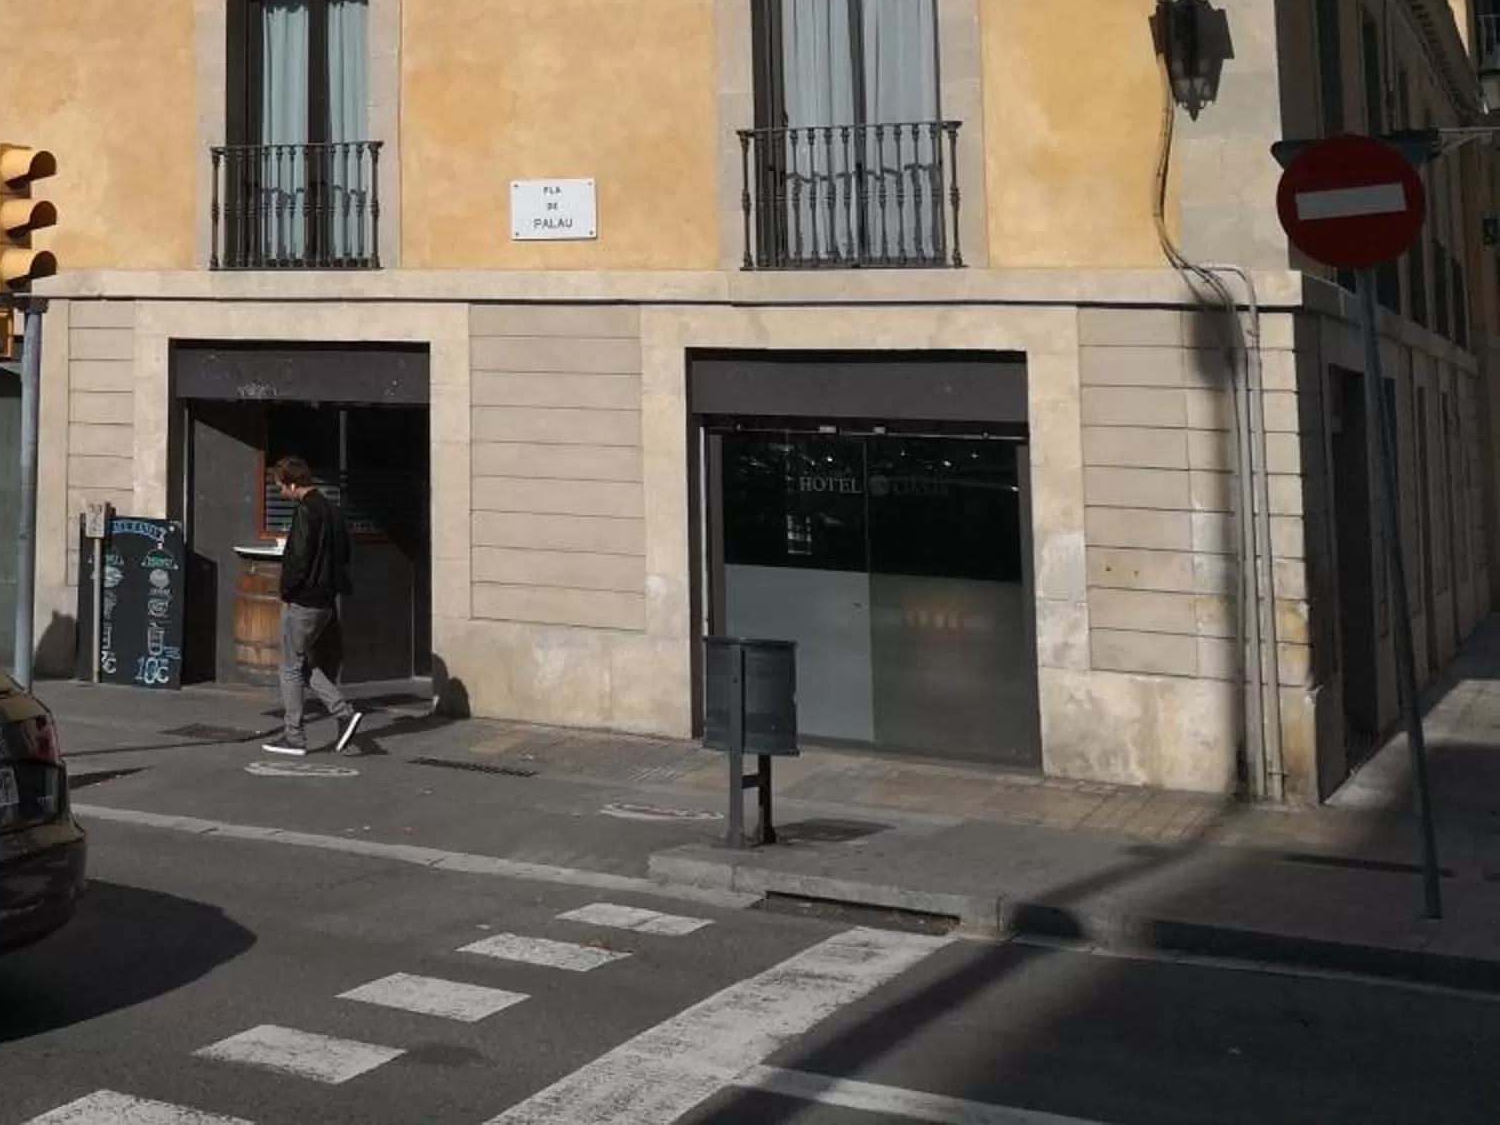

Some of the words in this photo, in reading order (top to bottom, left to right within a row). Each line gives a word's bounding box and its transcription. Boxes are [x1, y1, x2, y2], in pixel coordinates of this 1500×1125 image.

[543, 185, 561, 195] PLA
[547, 202, 558, 211] DE
[533, 218, 573, 230] PALAU
[799, 475, 864, 494] HOTEL
